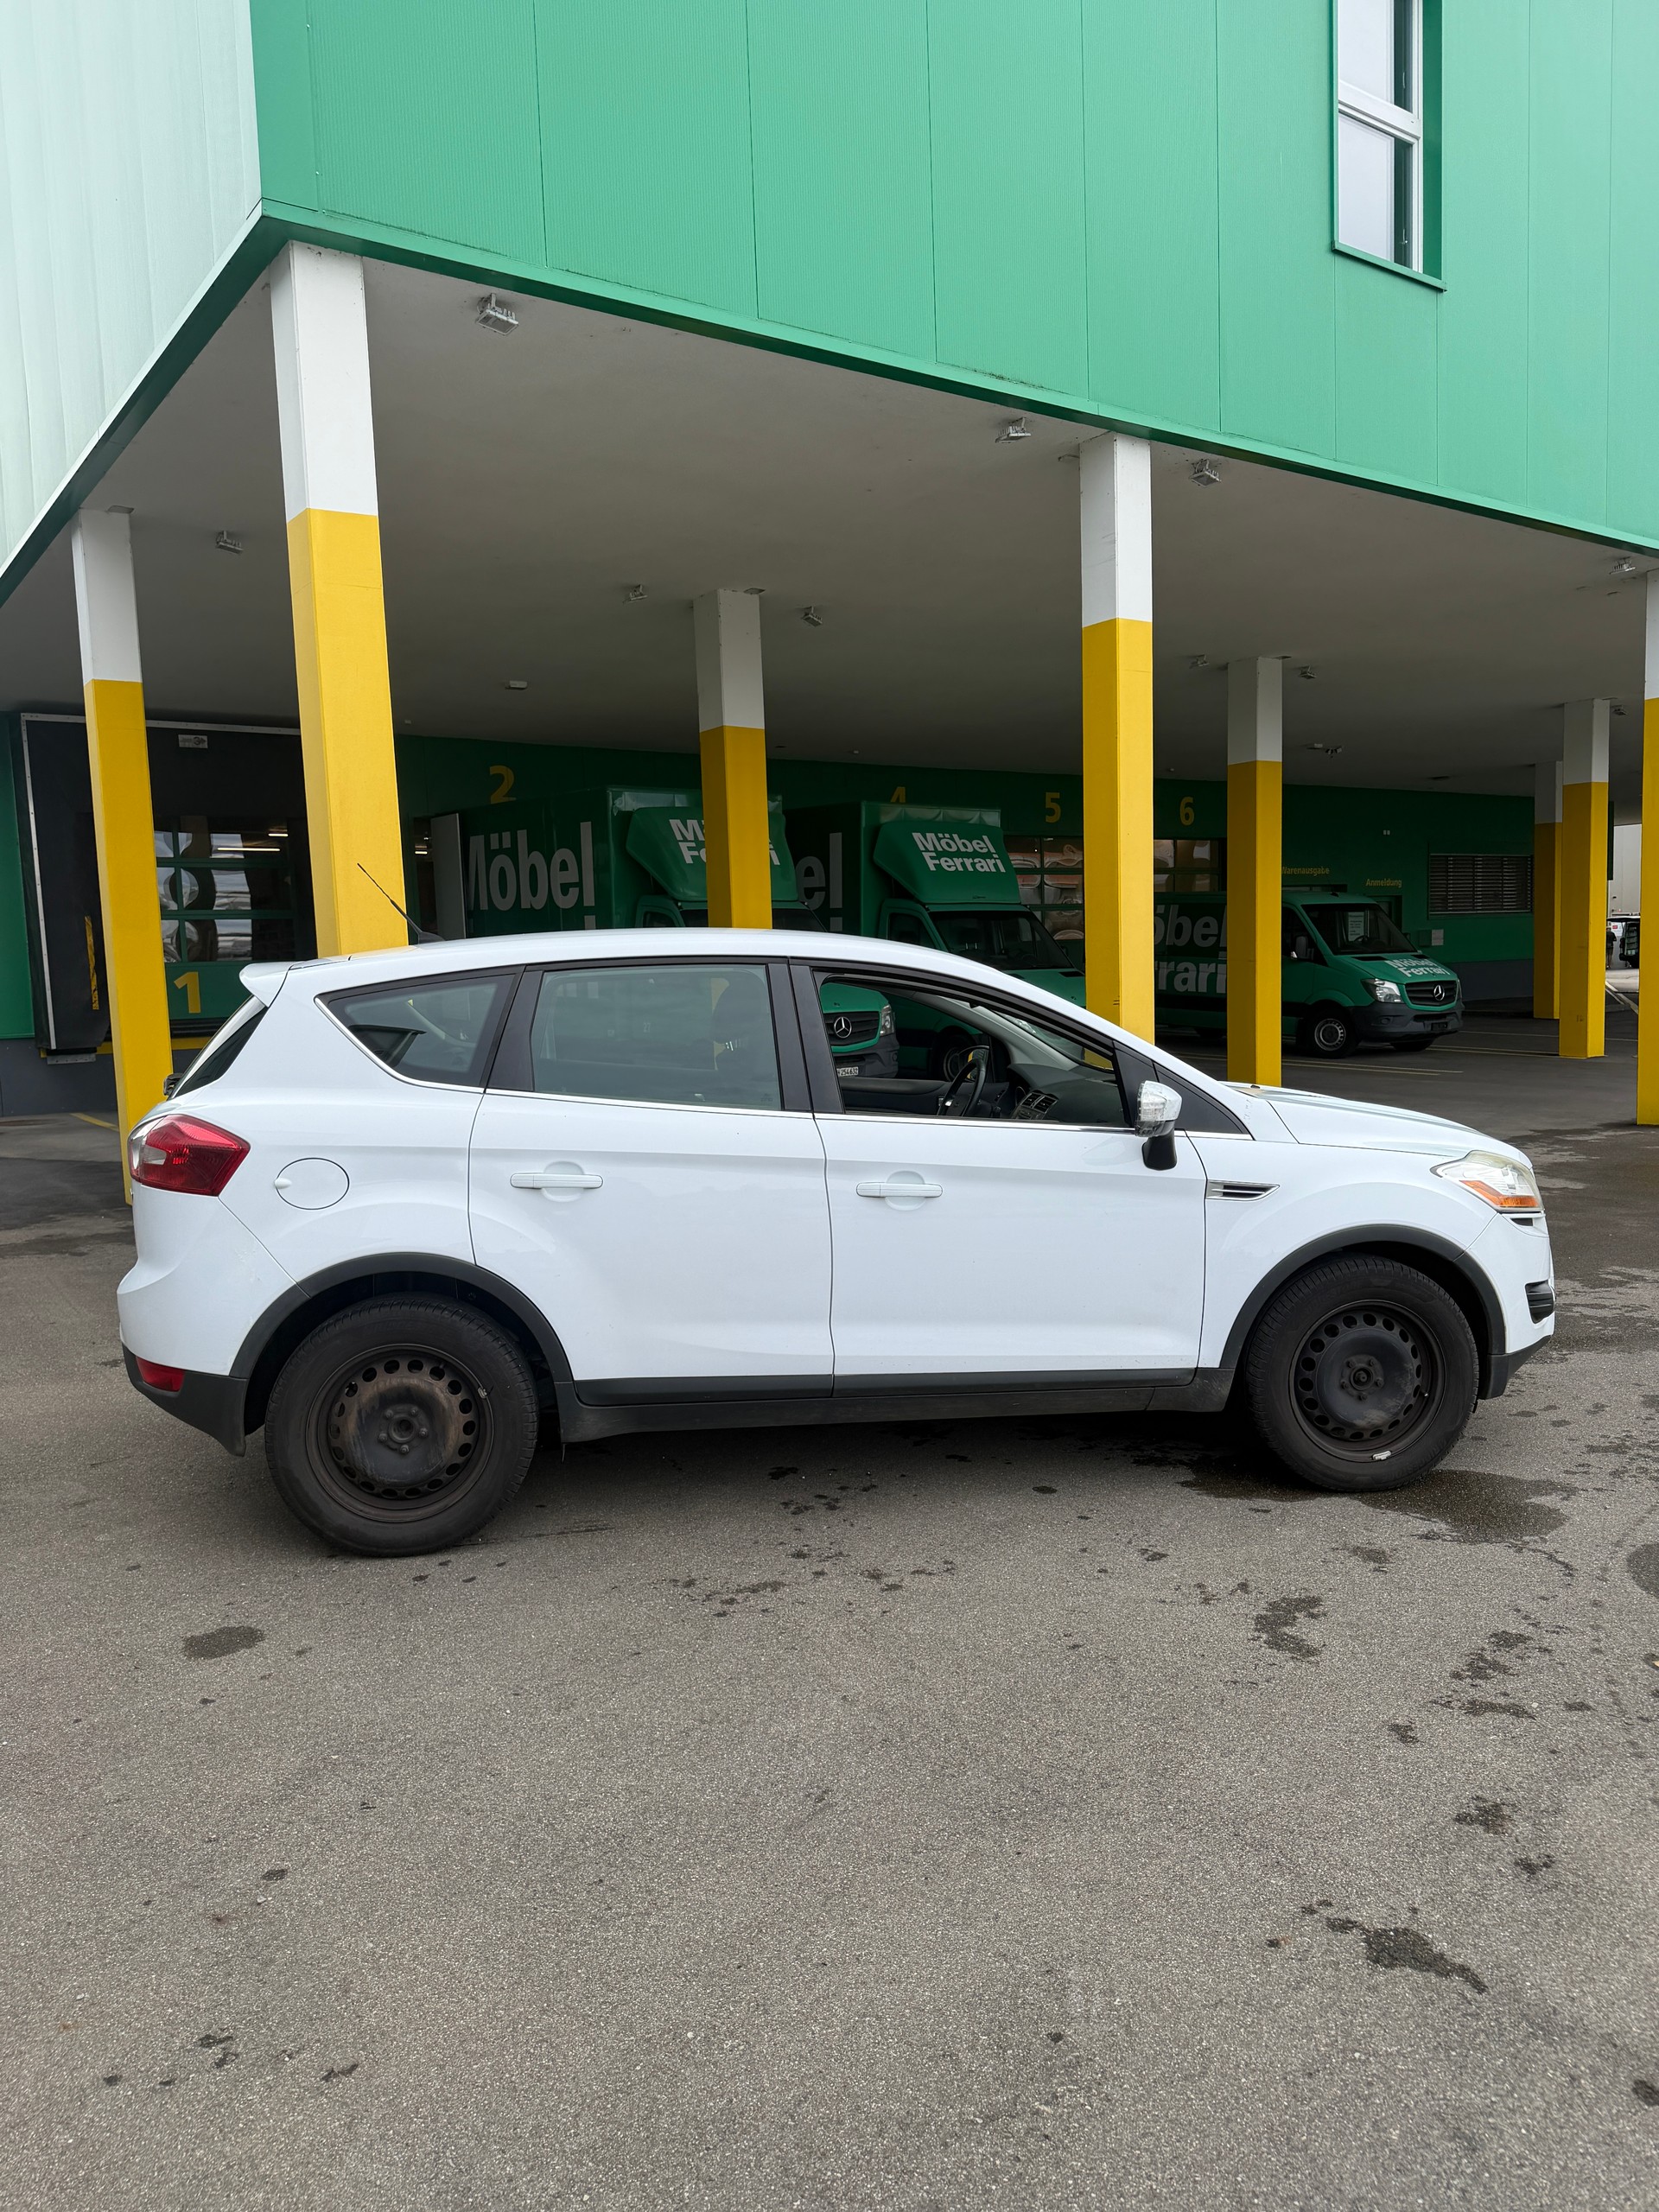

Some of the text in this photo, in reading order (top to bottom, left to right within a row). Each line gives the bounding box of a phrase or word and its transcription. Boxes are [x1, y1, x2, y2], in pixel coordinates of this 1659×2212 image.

[489, 764, 517, 804] 2
[1044, 791, 1063, 823] 5
[1179, 796, 1195, 826] 6
[912, 832, 996, 854] Möbel
[921, 852, 1007, 873] Ferrari
[1365, 878, 1402, 889] Anmeldung
[174, 971, 201, 1014] 1
